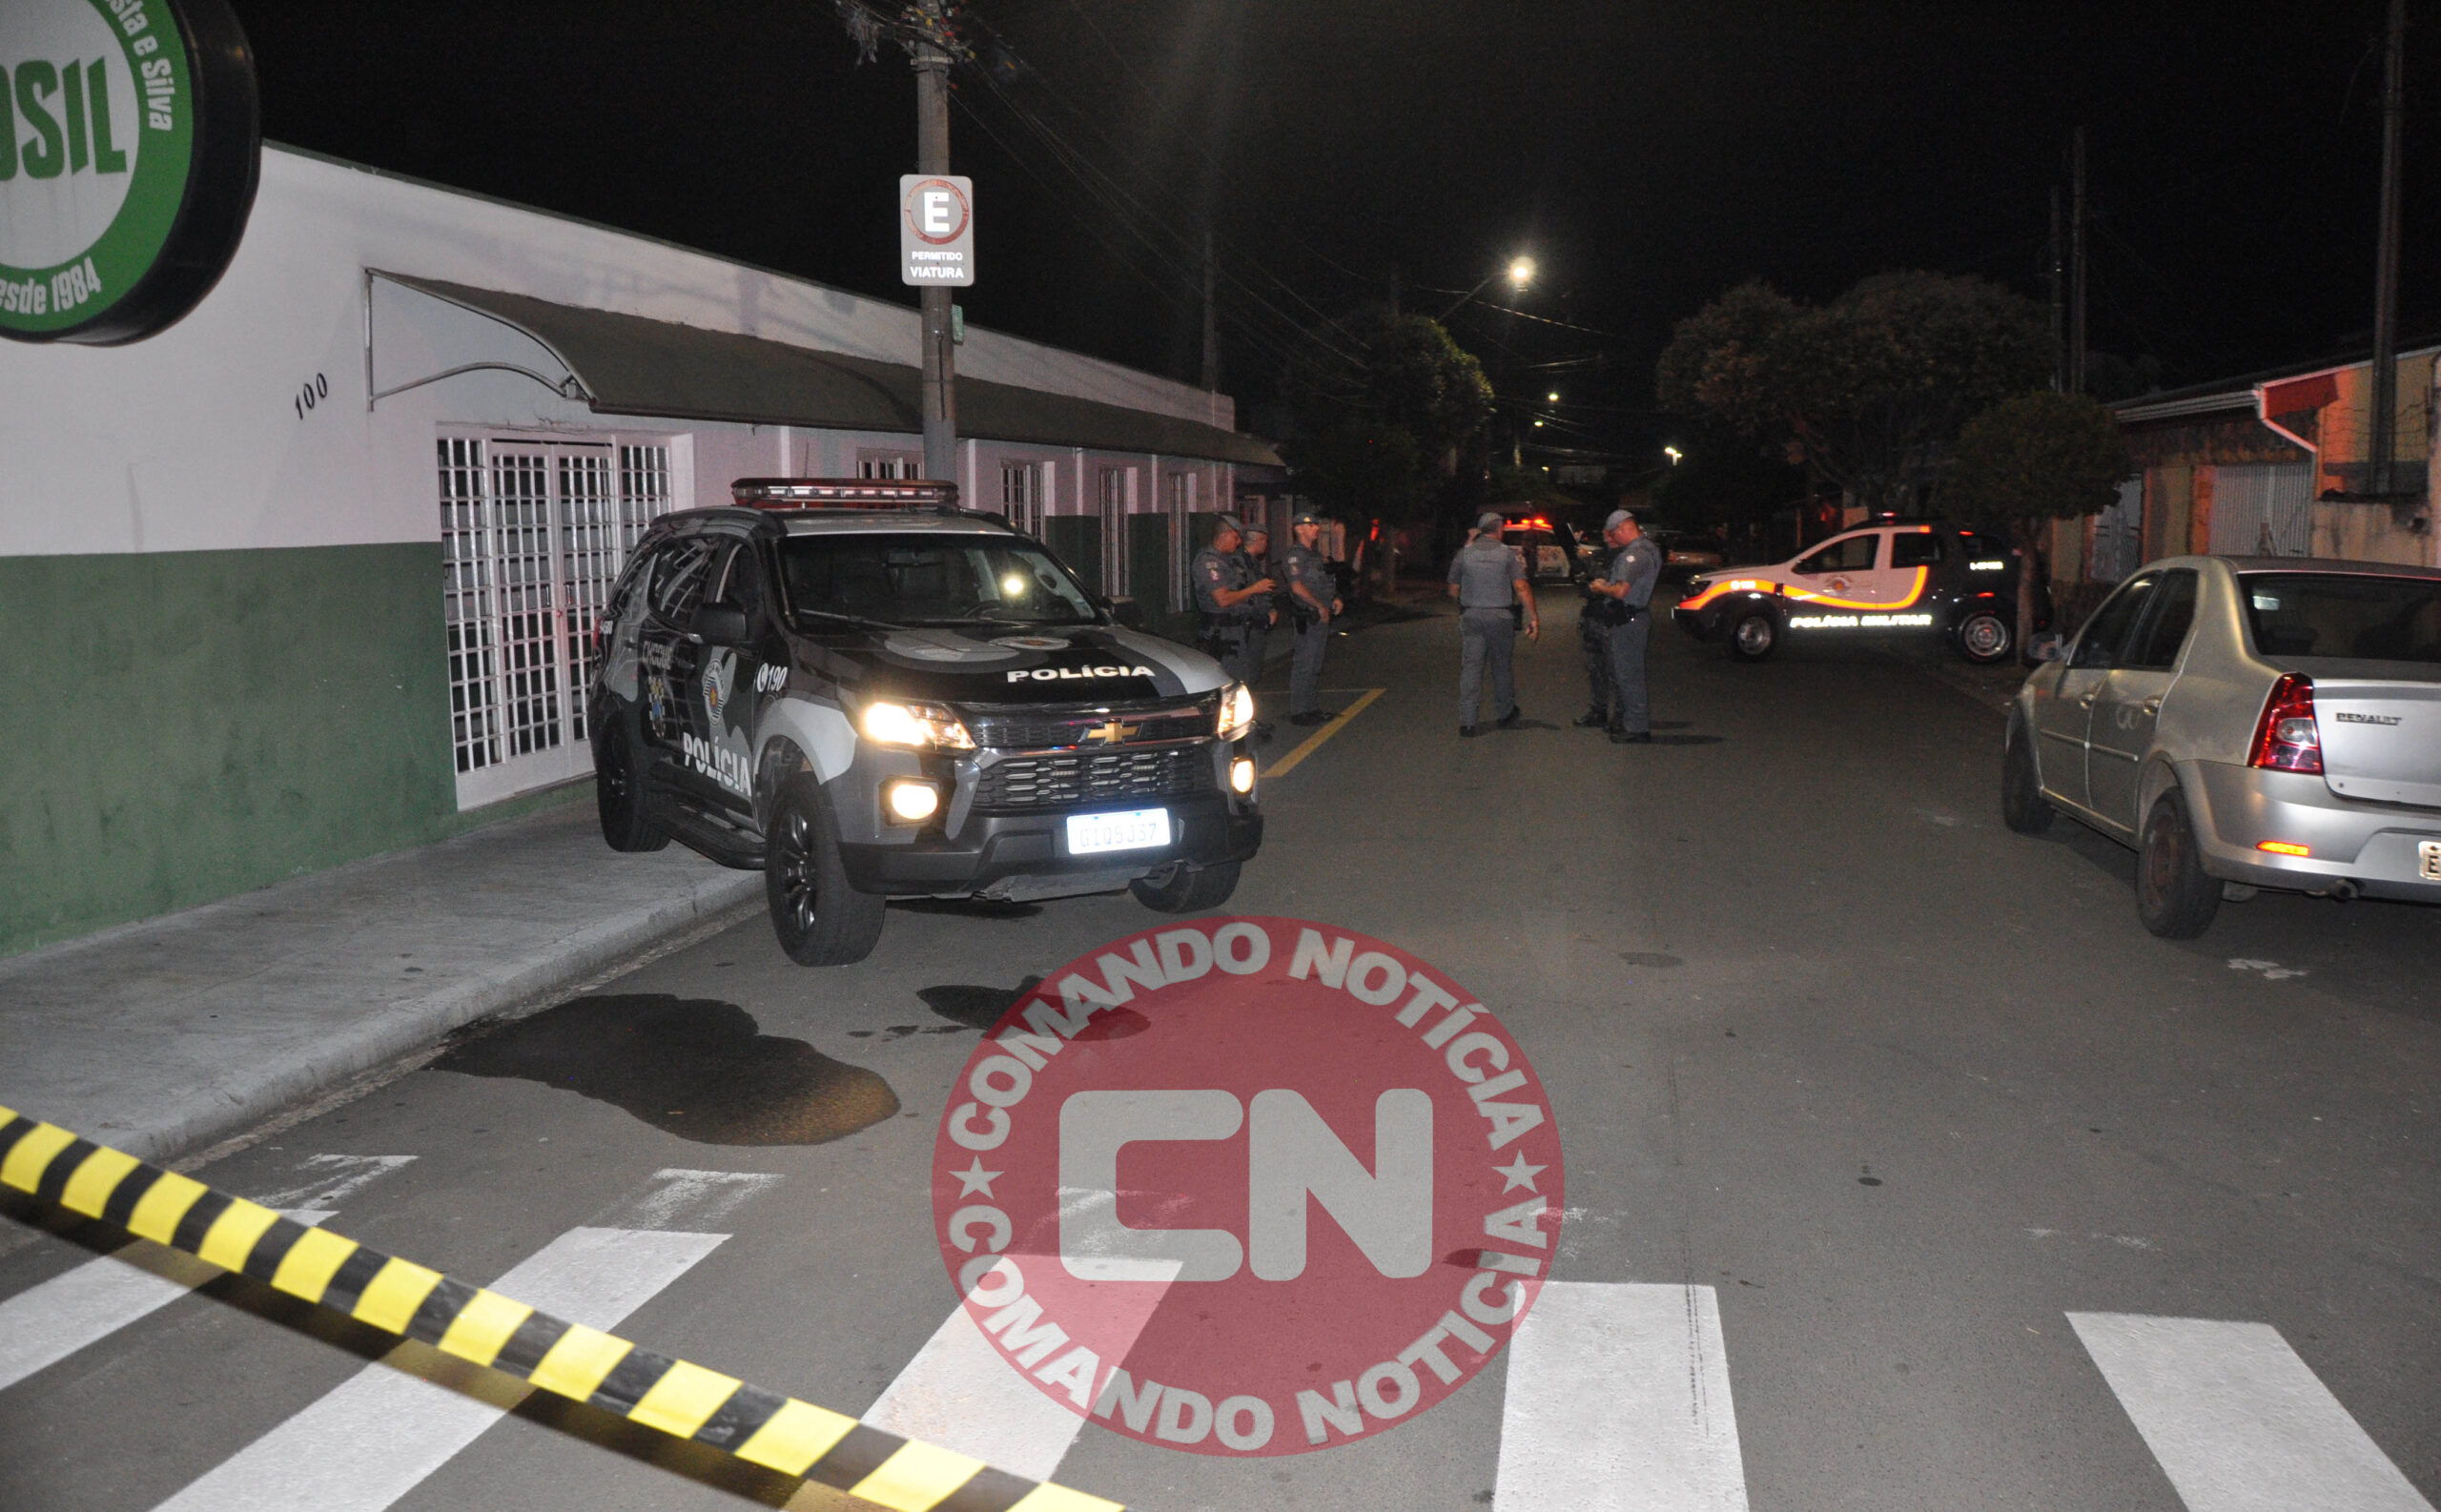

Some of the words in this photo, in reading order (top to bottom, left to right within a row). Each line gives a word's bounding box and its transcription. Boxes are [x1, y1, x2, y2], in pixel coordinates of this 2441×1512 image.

[133, 35, 158, 56] e
[141, 58, 175, 131] Silva
[924, 192, 950, 232] E
[910, 266, 964, 278] VIATURA
[912, 251, 963, 261] PERMITIDO
[51, 255, 102, 313] 1984
[296, 373, 327, 420] 100
[768, 664, 788, 691] 190
[1007, 664, 1156, 683] POLÍCIA
[683, 731, 752, 797] POLÍCIA
